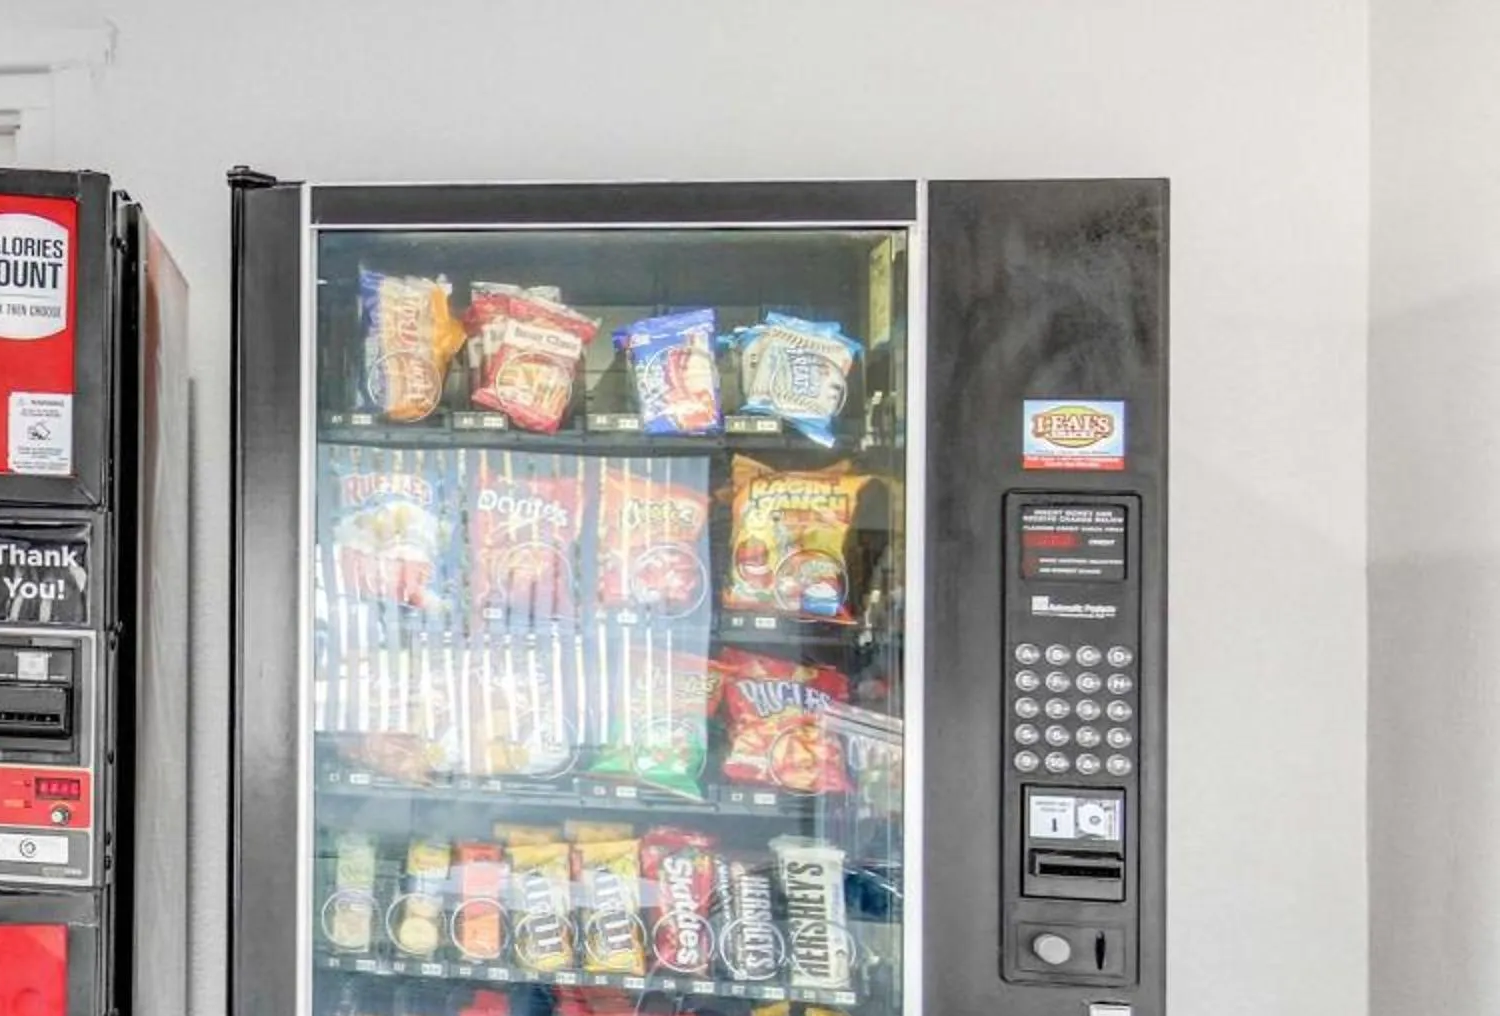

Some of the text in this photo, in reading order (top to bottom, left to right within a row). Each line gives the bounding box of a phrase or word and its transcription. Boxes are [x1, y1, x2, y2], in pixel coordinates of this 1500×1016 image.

[29, 305, 62, 319] CHOOSE
[476, 487, 570, 527] Doritos
[2, 576, 66, 600] You!
[662, 855, 700, 966] Skittles
[738, 873, 777, 976] HERSHEY'S
[786, 860, 832, 979] HERSHEY'S
